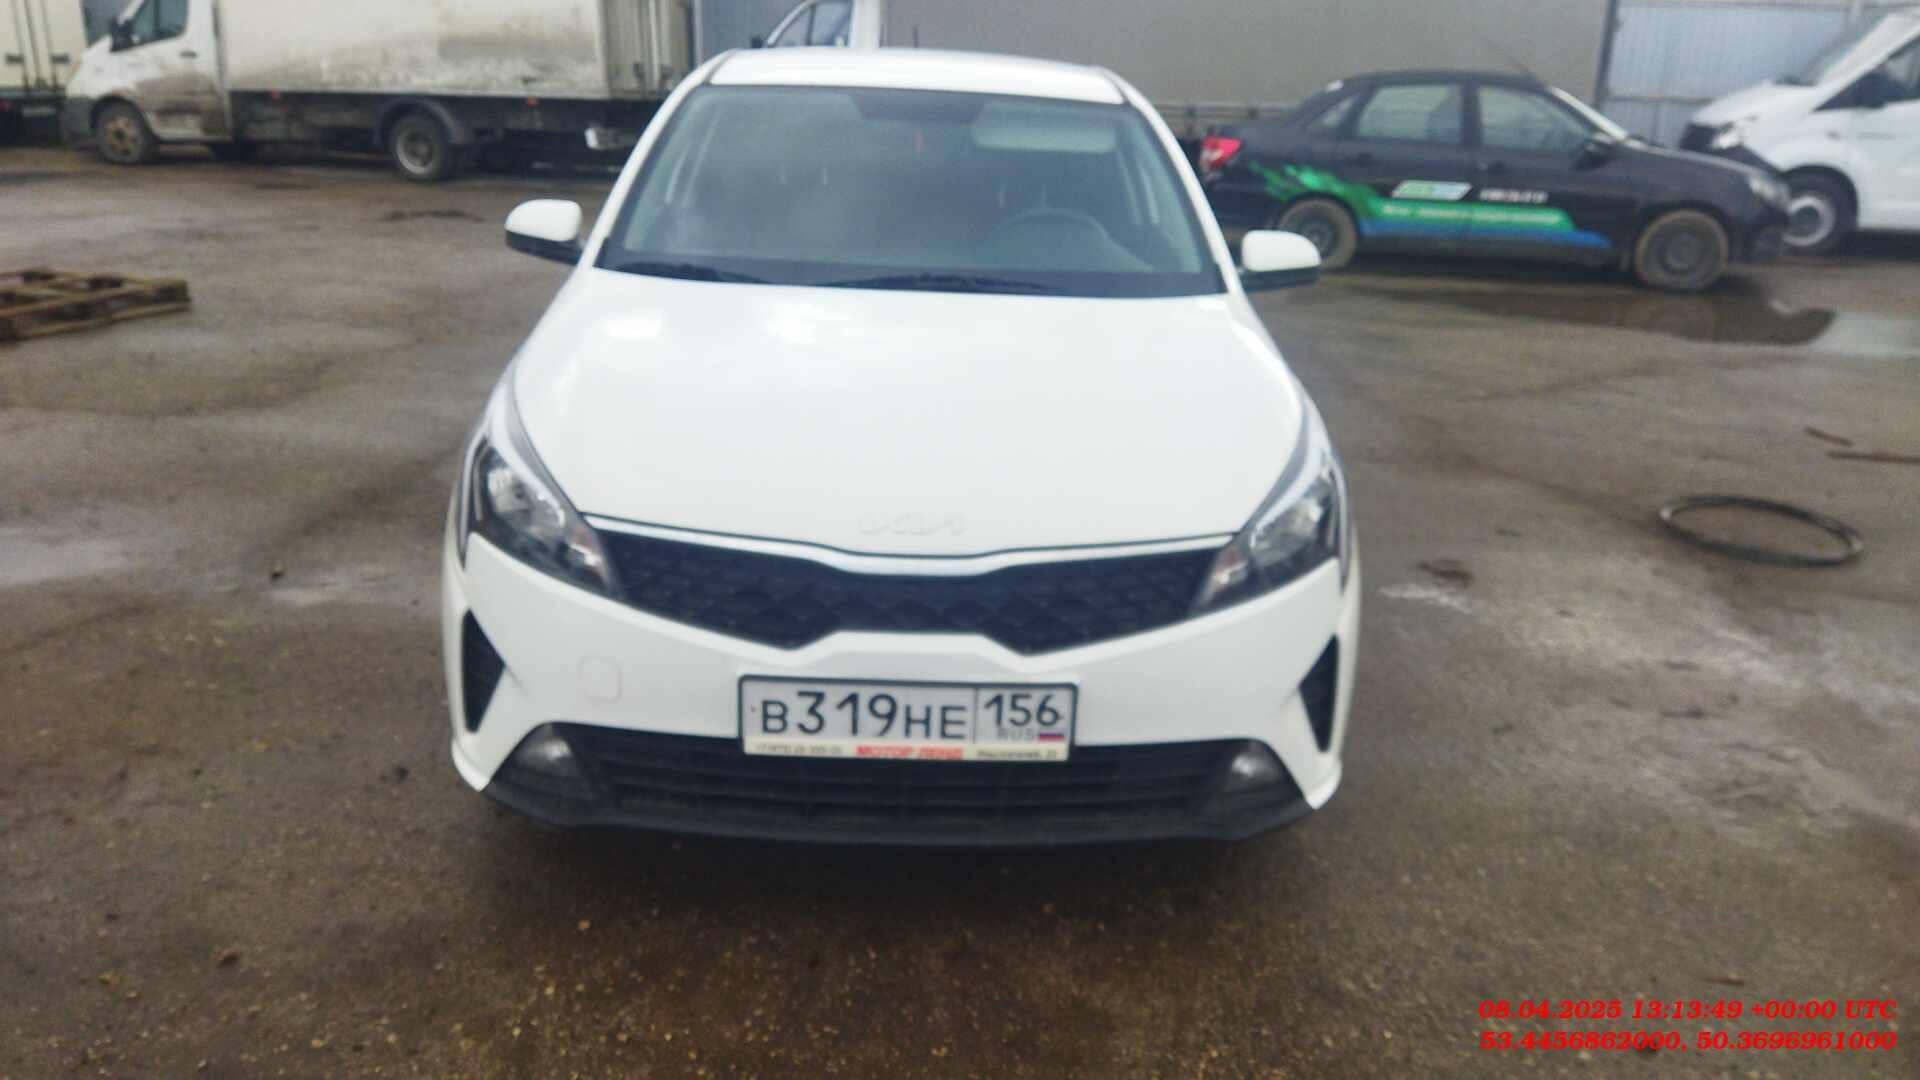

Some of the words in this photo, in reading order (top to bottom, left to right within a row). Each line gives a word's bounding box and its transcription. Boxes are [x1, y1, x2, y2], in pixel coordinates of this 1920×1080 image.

[761, 690, 967, 740] В319НЕ
[984, 693, 1061, 728] 156
[997, 728, 1035, 741] RUS
